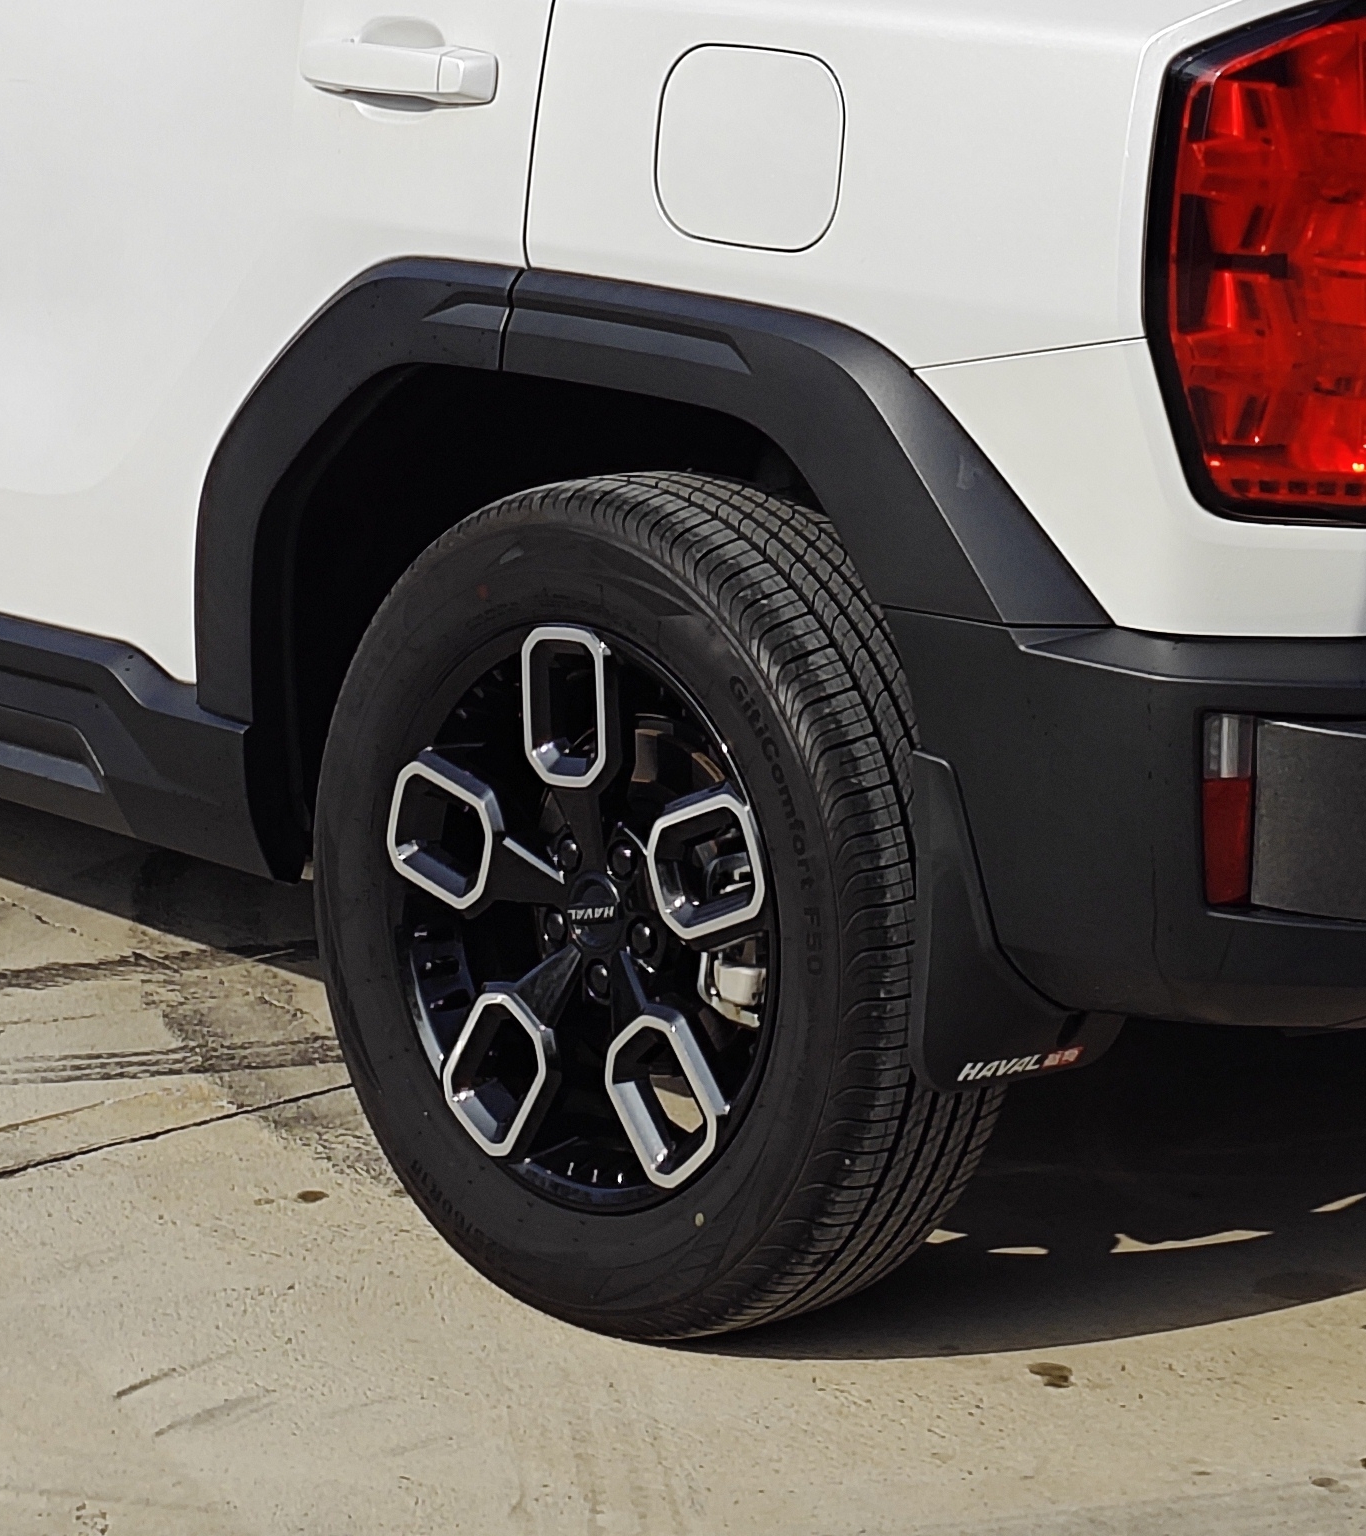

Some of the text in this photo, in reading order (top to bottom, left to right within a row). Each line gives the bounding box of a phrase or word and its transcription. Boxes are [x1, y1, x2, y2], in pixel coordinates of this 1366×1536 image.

[729, 675, 824, 976] GitiComfort F50
[567, 905, 615, 920] HAVAL
[956, 1053, 1042, 1082] HAVAL
